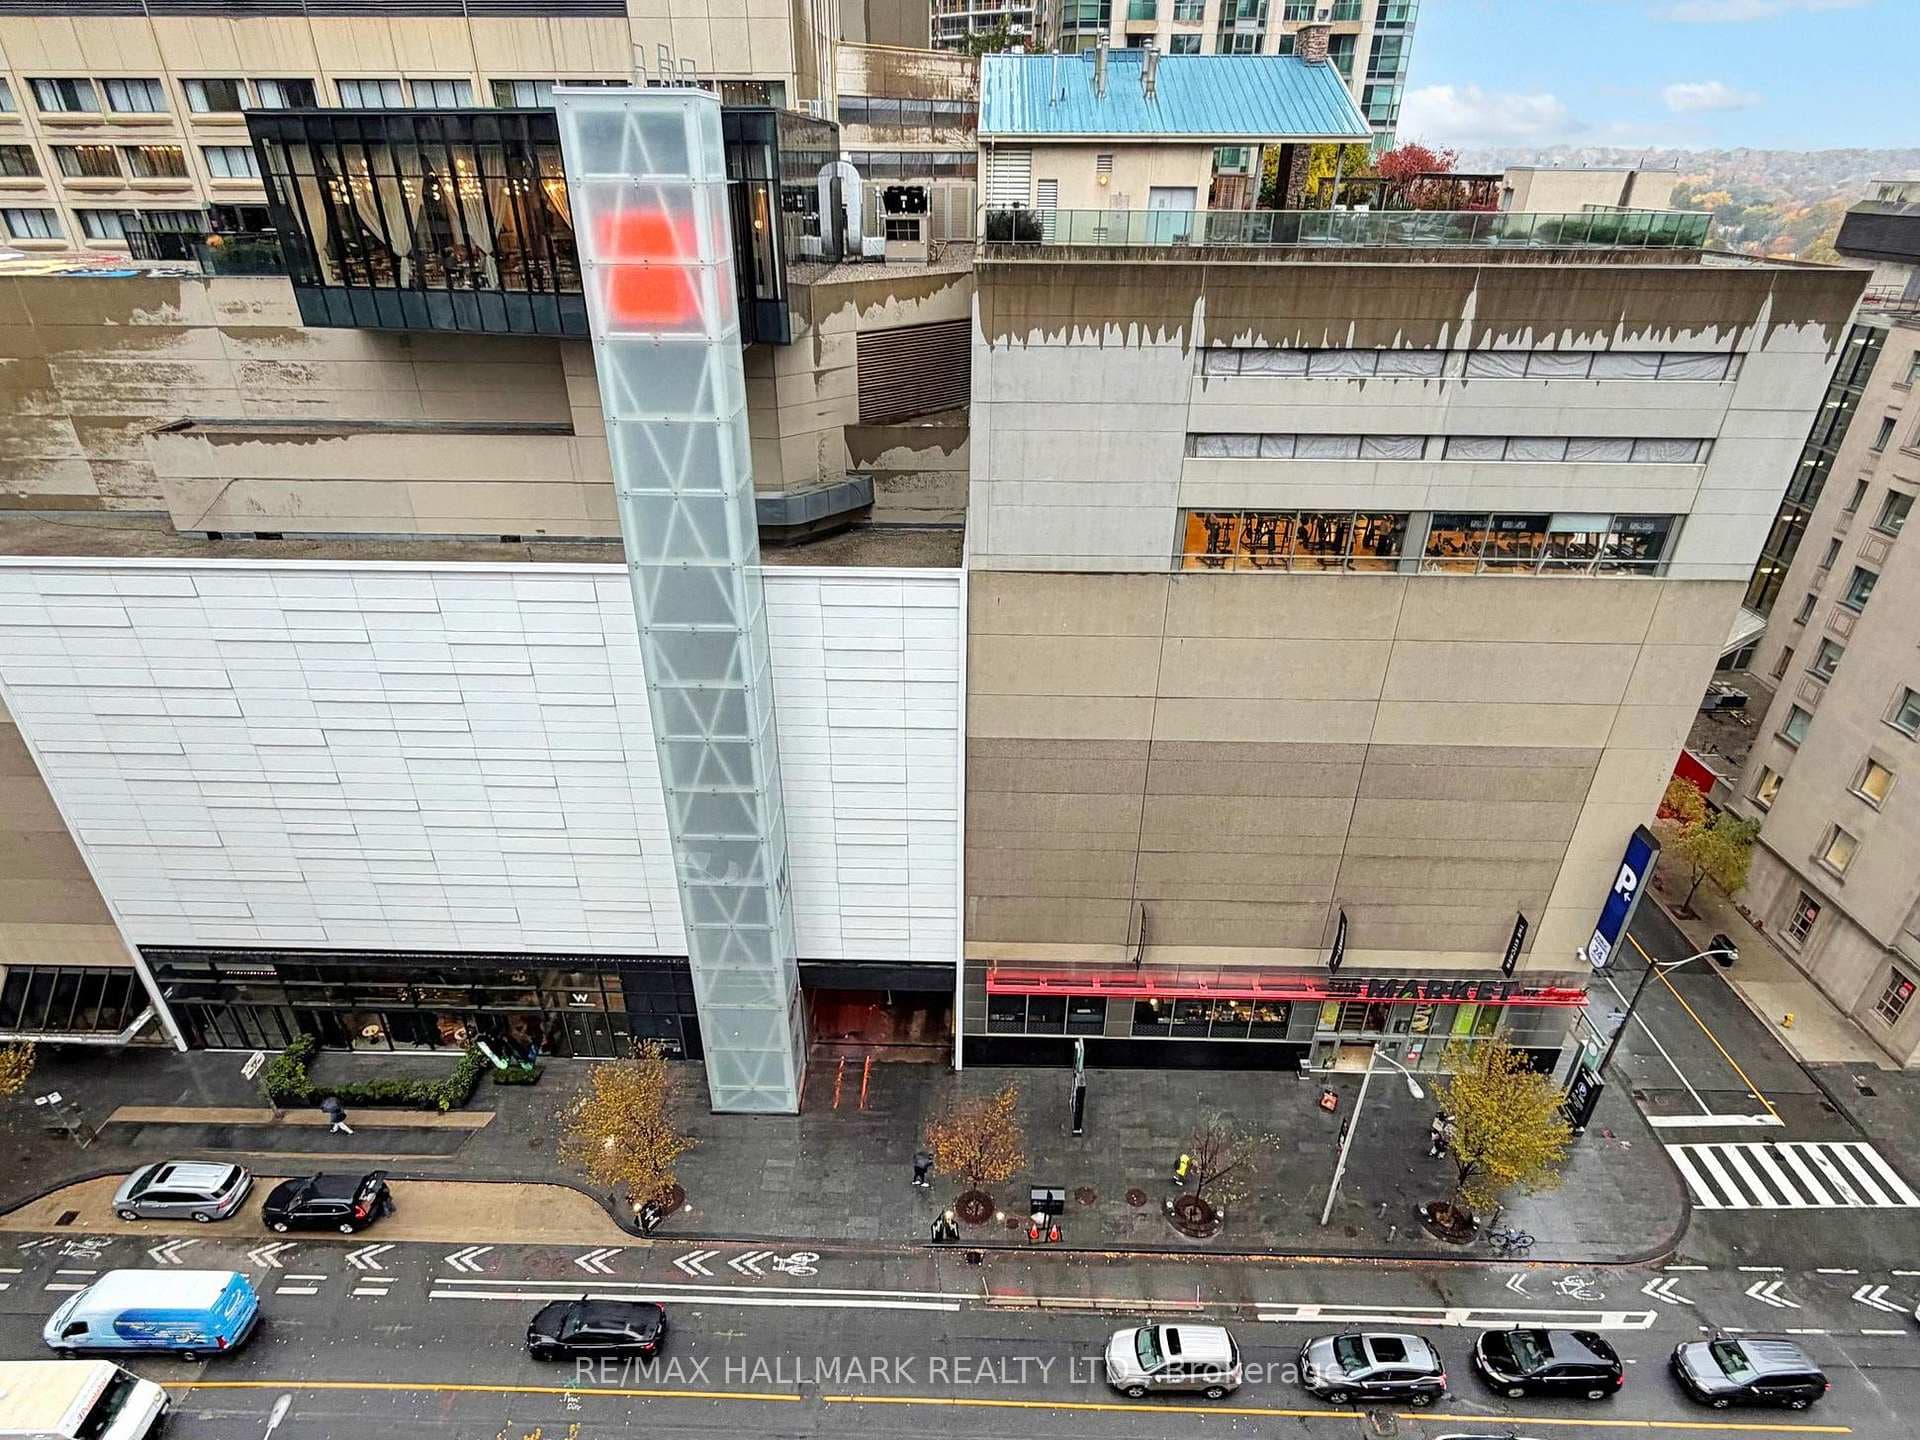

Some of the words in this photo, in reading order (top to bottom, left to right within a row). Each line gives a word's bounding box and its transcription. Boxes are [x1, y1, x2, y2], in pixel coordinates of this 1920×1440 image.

[1614, 863, 1638, 894] P
[572, 993, 588, 1003] W
[1367, 979, 1520, 1000] MARKET
